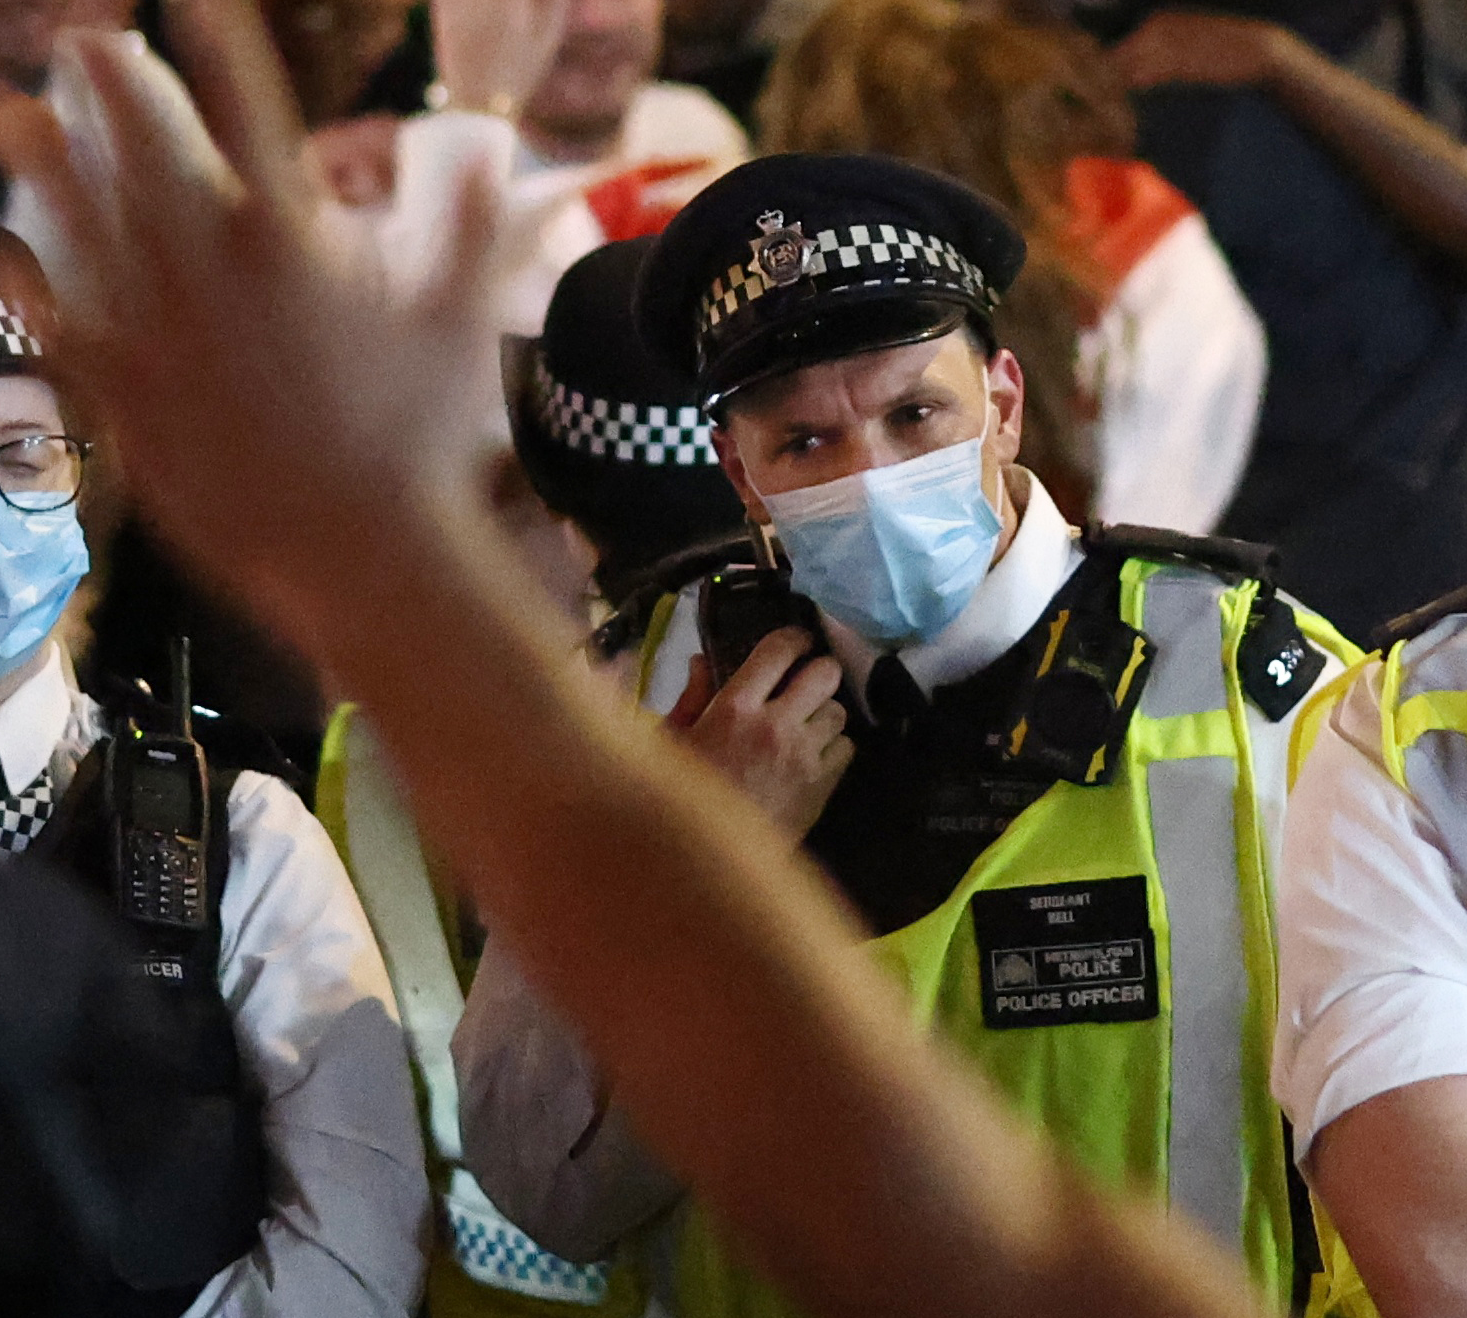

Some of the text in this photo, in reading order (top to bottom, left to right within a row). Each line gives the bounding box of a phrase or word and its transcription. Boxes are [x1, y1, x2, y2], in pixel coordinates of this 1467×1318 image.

[1059, 960, 1121, 979] POLICE
[996, 985, 1145, 1013] POLICE OFFICER
